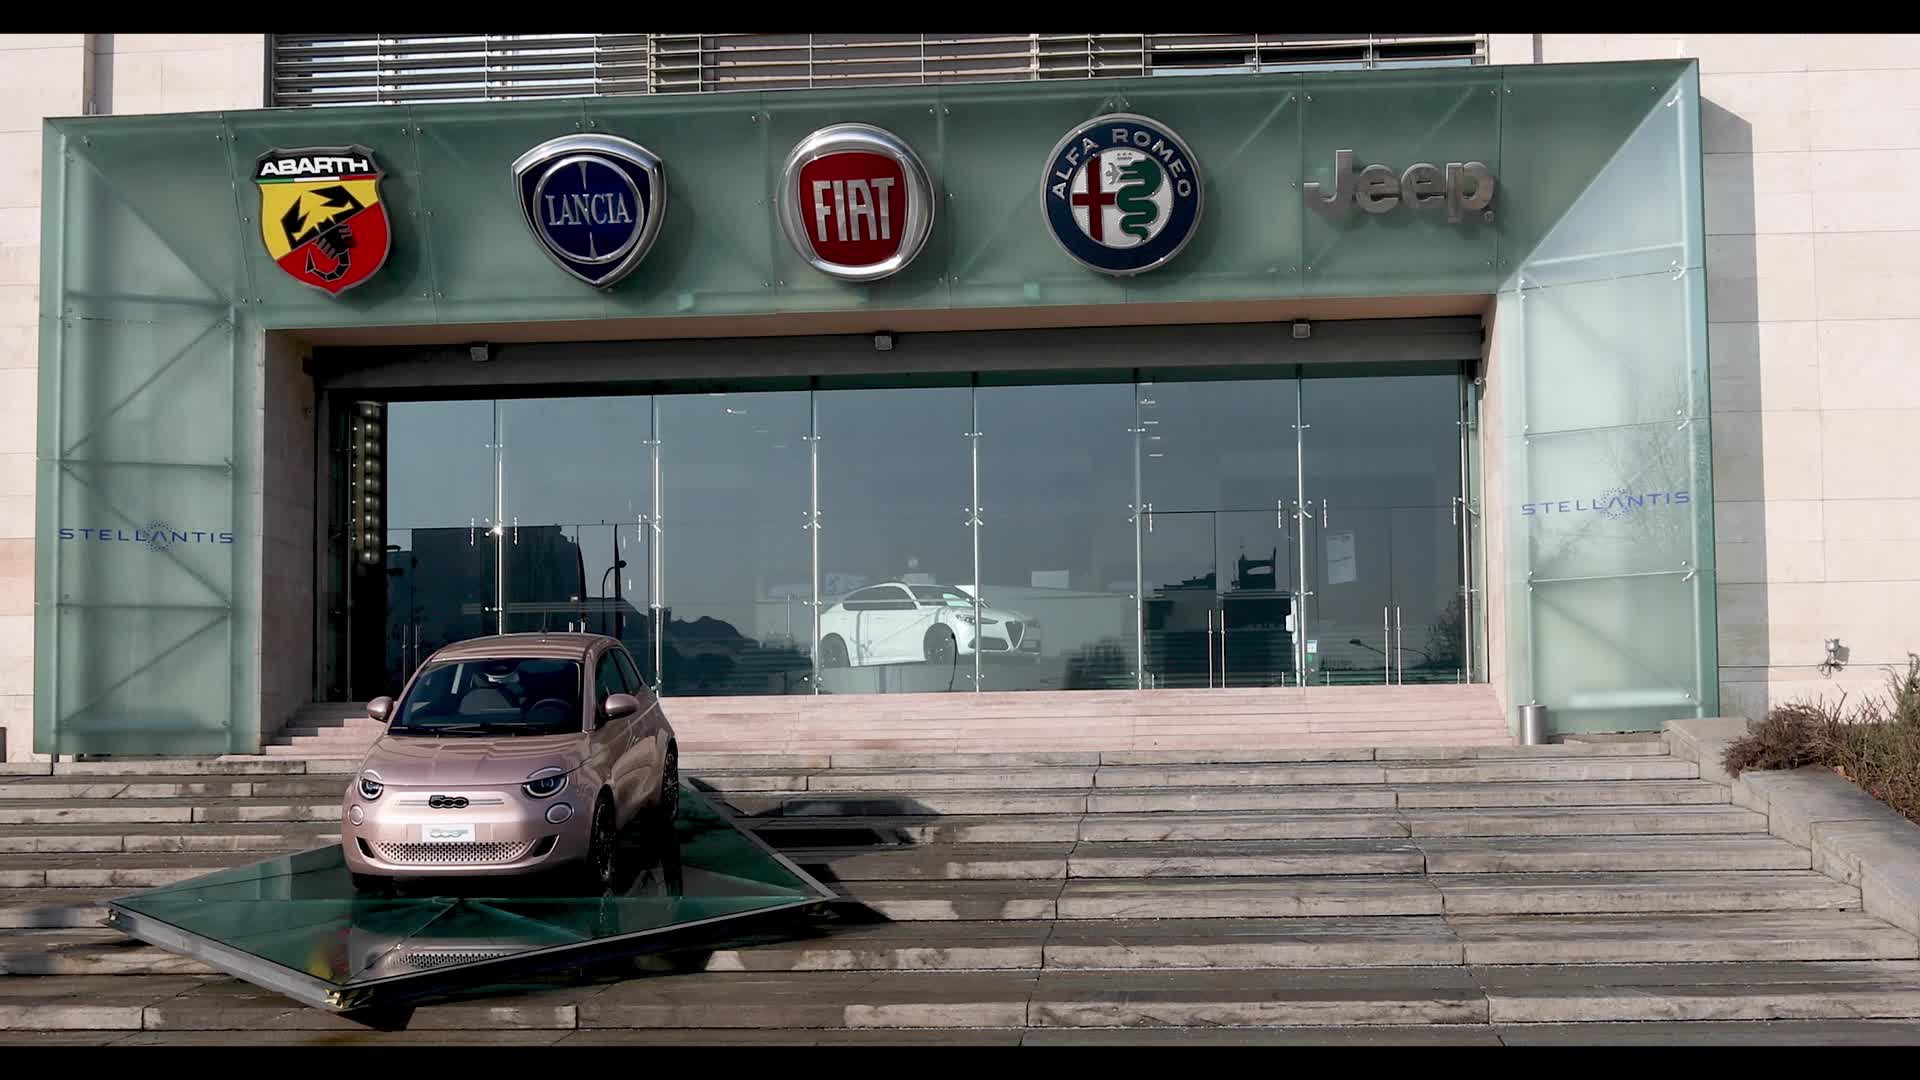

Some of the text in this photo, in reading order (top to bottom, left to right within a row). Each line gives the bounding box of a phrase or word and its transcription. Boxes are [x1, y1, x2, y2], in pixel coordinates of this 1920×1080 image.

[260, 157, 368, 176] ABARTH
[1052, 128, 1192, 200] ALFA ROMEO
[545, 192, 632, 226] LANCIA
[812, 177, 895, 241] FIAT
[1521, 491, 1690, 516] STELLANTIS
[58, 528, 233, 544] STELLANTIS
